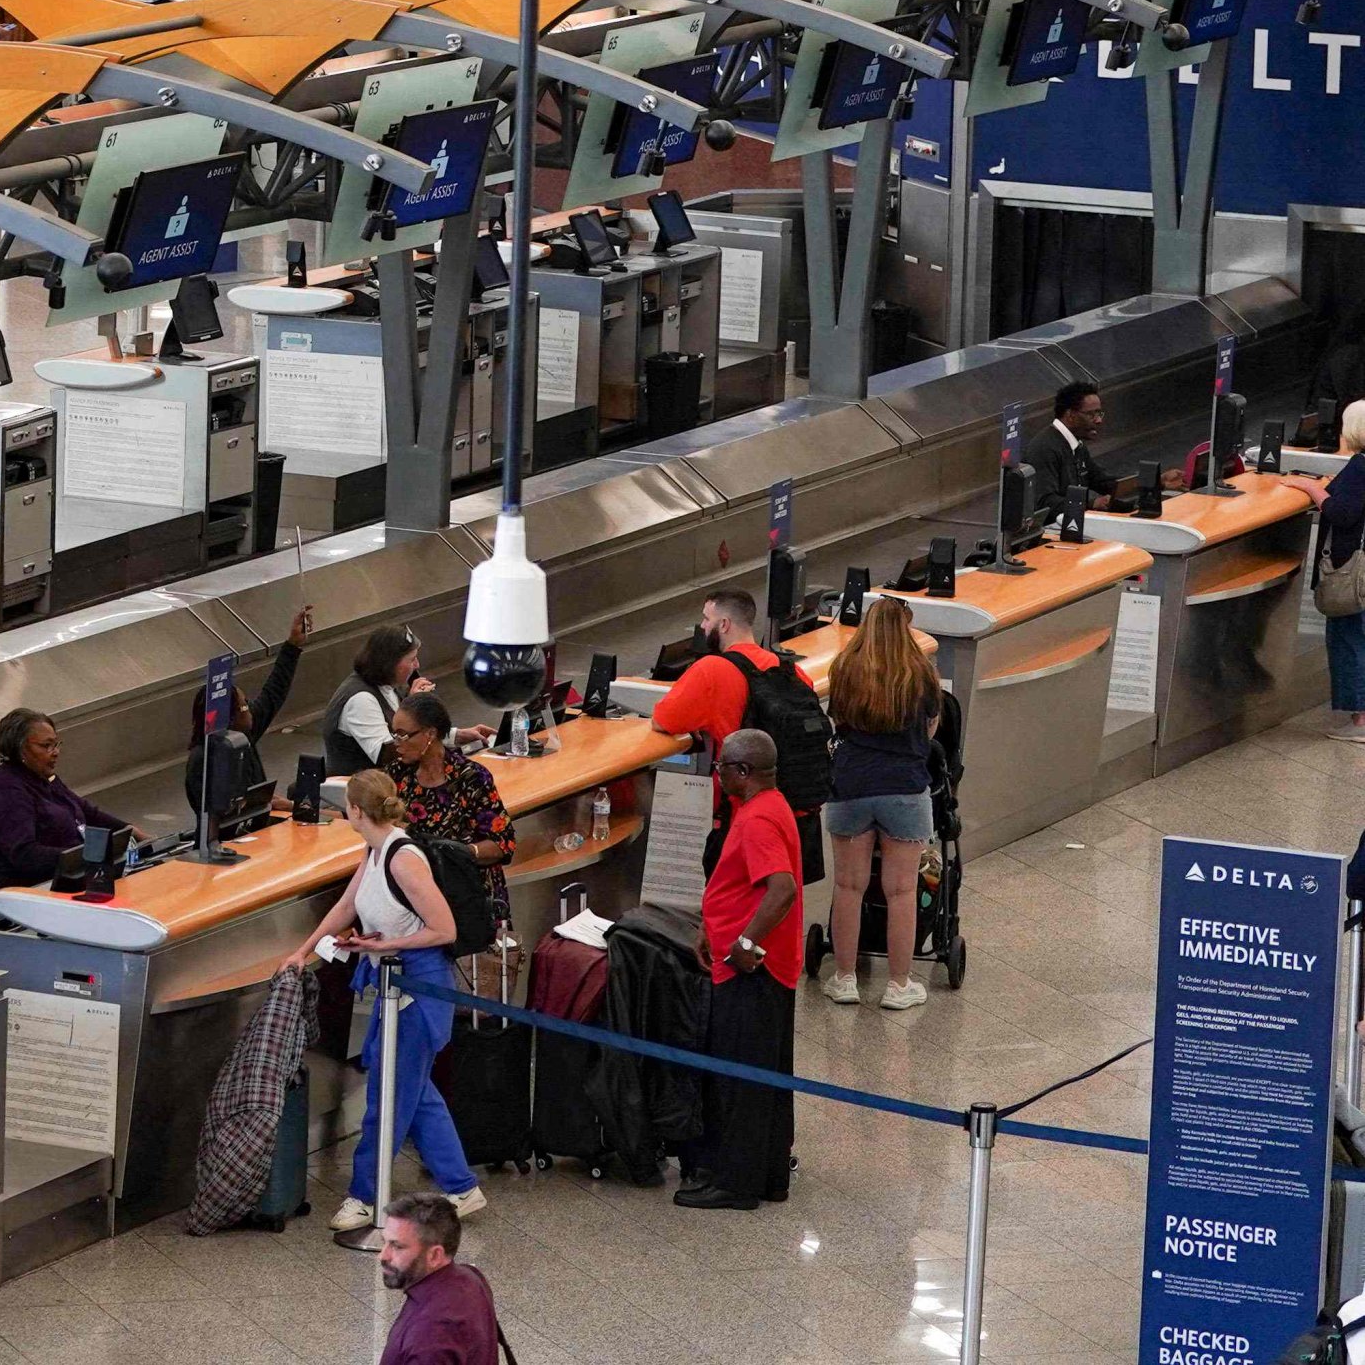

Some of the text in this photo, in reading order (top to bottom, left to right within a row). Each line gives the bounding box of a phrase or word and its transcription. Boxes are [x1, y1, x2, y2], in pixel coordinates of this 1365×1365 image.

[690, 19, 700, 33] 66
[608, 35, 619, 50] 65
[1030, 46, 1069, 65] AGENT ASSIST
[369, 81, 381, 96] 63
[843, 88, 887, 107] AGENT ASSIST
[469, 112, 486, 122] DELTA
[106, 132, 118, 148] 61
[662, 132, 685, 147] ASSIST
[213, 166, 232, 177] DELTA
[430, 183, 458, 200] ASSIST
[138, 240, 199, 265] AGENT ASSIST
[1213, 865, 1293, 891] DELTA
[1179, 917, 1280, 946] EFFECTIVE
[1179, 939, 1317, 973] IMMEDIATELY
[1178, 982, 1281, 1002] Transportation Security Administration
[1186, 976, 1202, 985] Order
[1219, 980, 1251, 991] Department
[1259, 985, 1287, 995] Homeland
[1288, 988, 1310, 998] Security
[1187, 1005, 1217, 1014] FOLLOWING
[1217, 1008, 1253, 1019] RESTRICTIONS
[1253, 1013, 1268, 1021] APPLY
[1256, 1021, 1285, 1031] PASSENGER
[1166, 1215, 1277, 1246] PASSENGER
[1164, 1236, 1237, 1262] NOTICE
[1159, 1326, 1250, 1354] CHECKED
